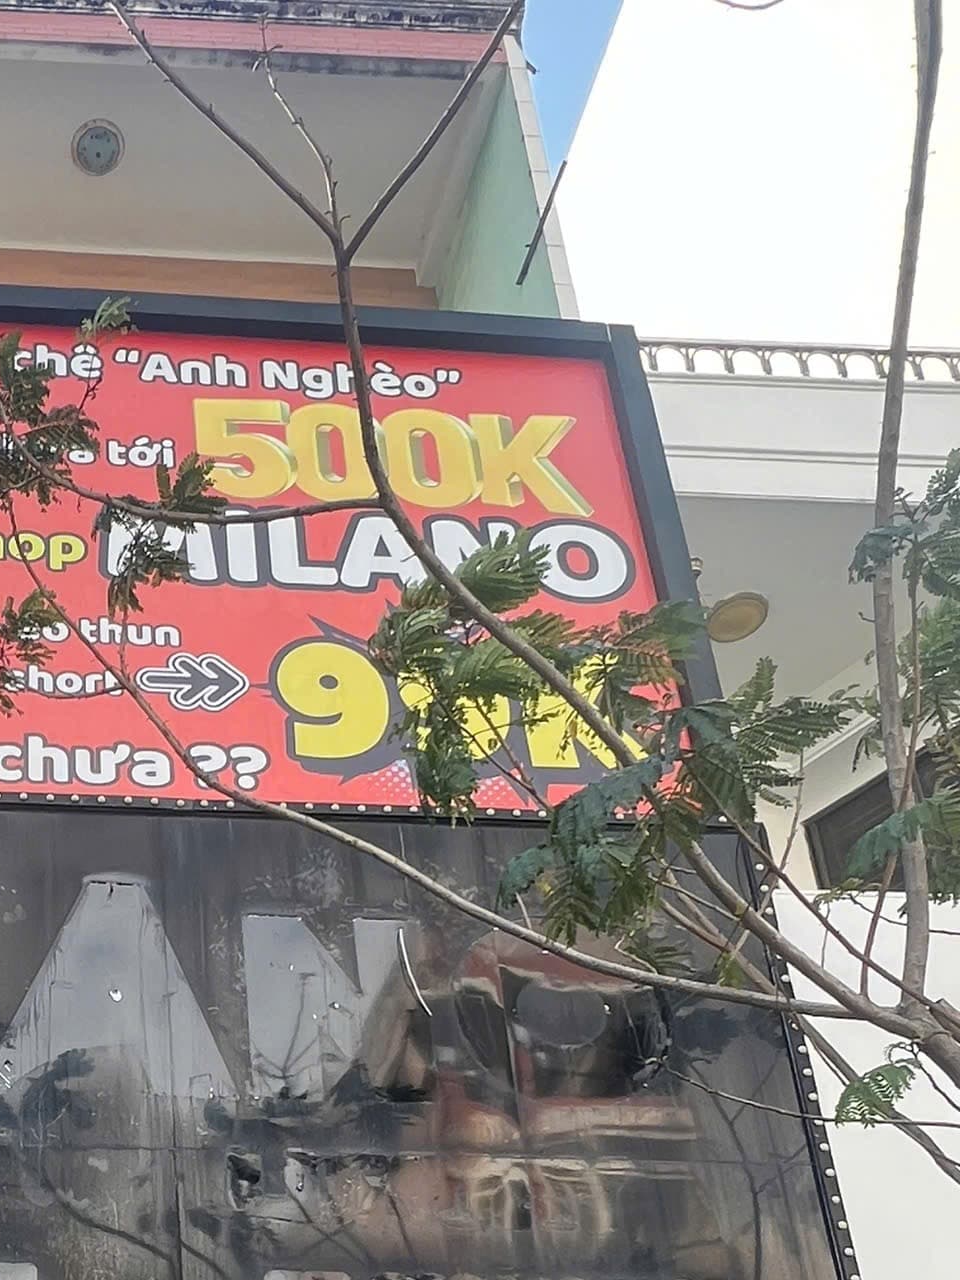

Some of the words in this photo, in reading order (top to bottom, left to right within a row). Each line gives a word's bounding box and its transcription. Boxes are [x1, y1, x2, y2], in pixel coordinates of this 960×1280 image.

[107, 436, 175, 468] tới
[192, 397, 594, 516] 500K
[105, 508, 629, 600] MILANO
[79, 616, 181, 647] thun
[189, 744, 268, 790] ??
